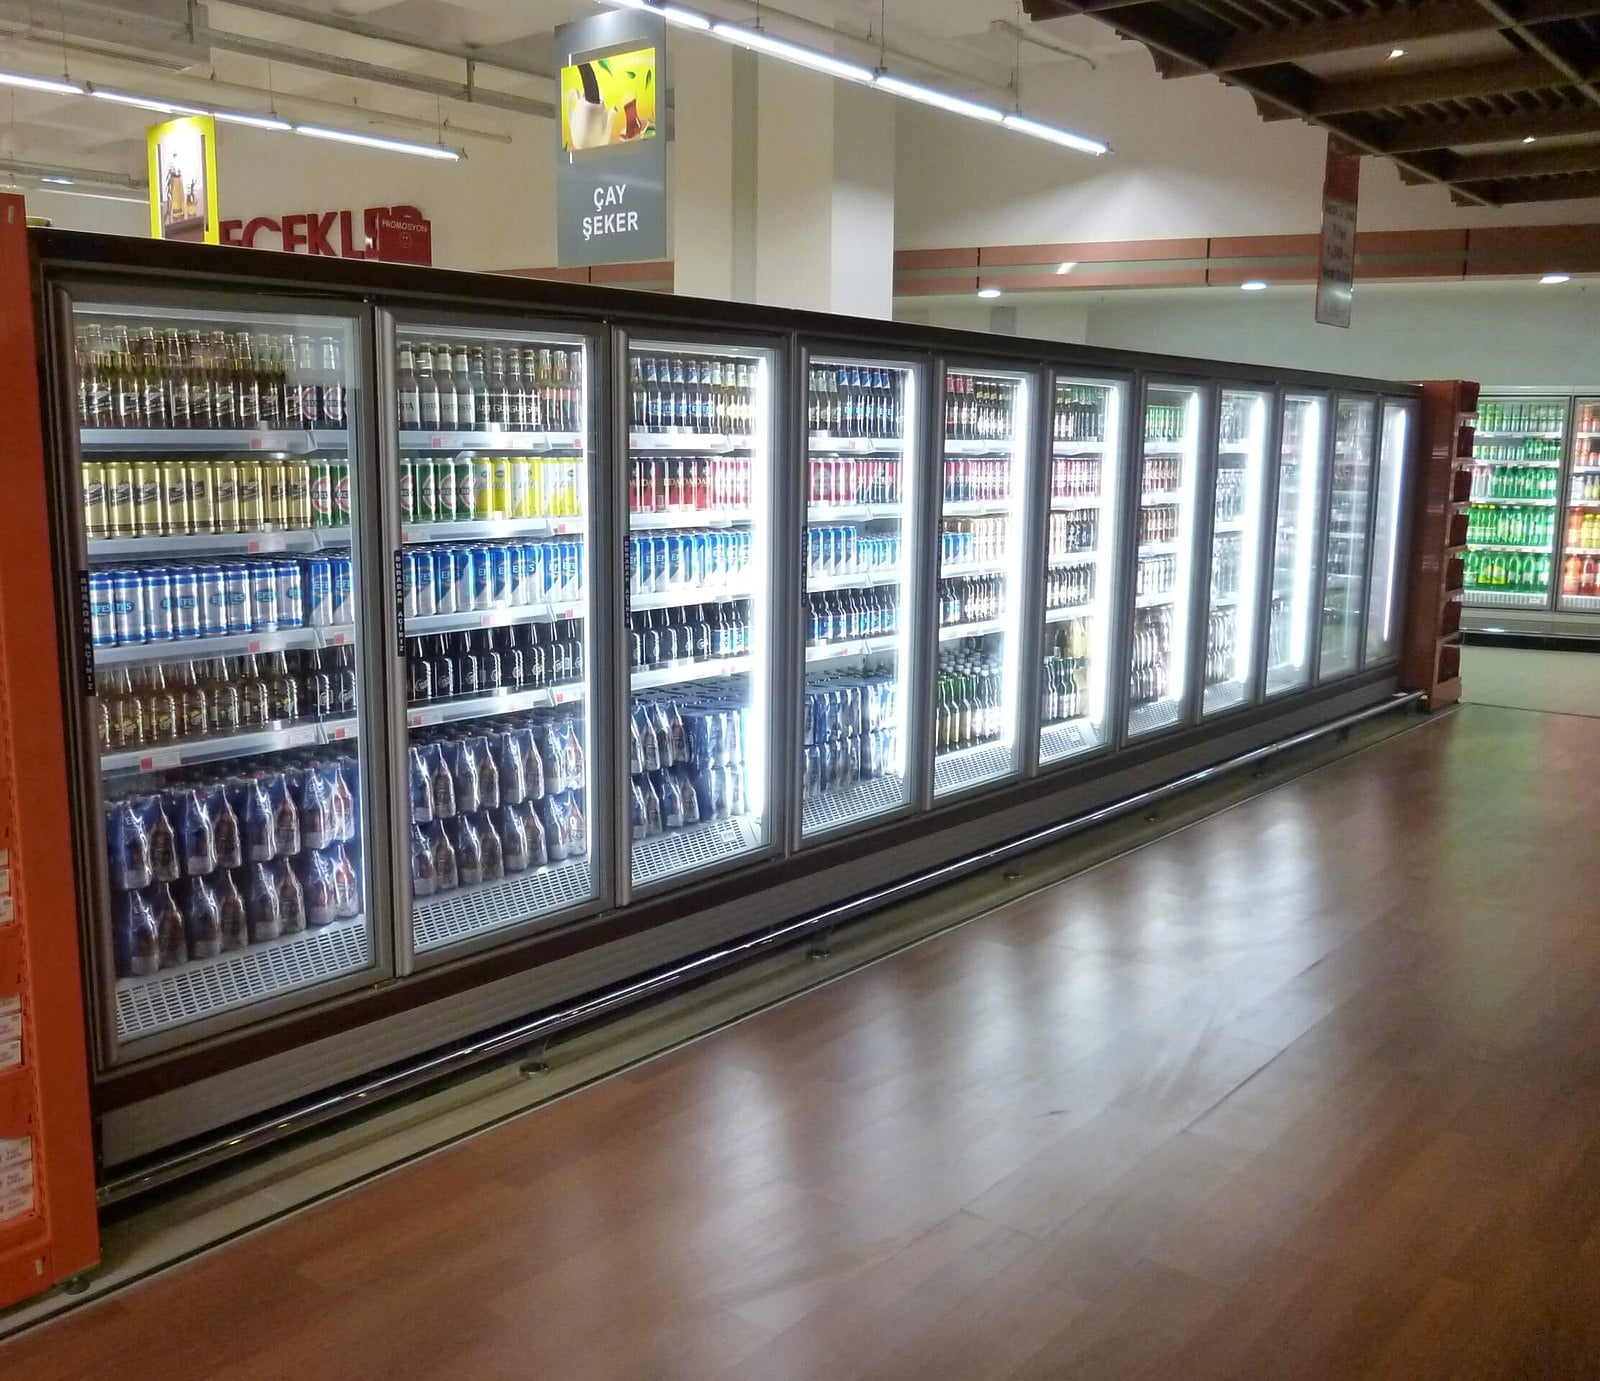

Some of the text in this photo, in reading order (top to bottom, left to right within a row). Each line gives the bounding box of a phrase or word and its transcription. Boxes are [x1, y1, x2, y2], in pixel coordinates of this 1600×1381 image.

[593, 184, 627, 212] ÇAY
[381, 218, 429, 233] PROMOSYON
[582, 211, 639, 241] ŞEKER
